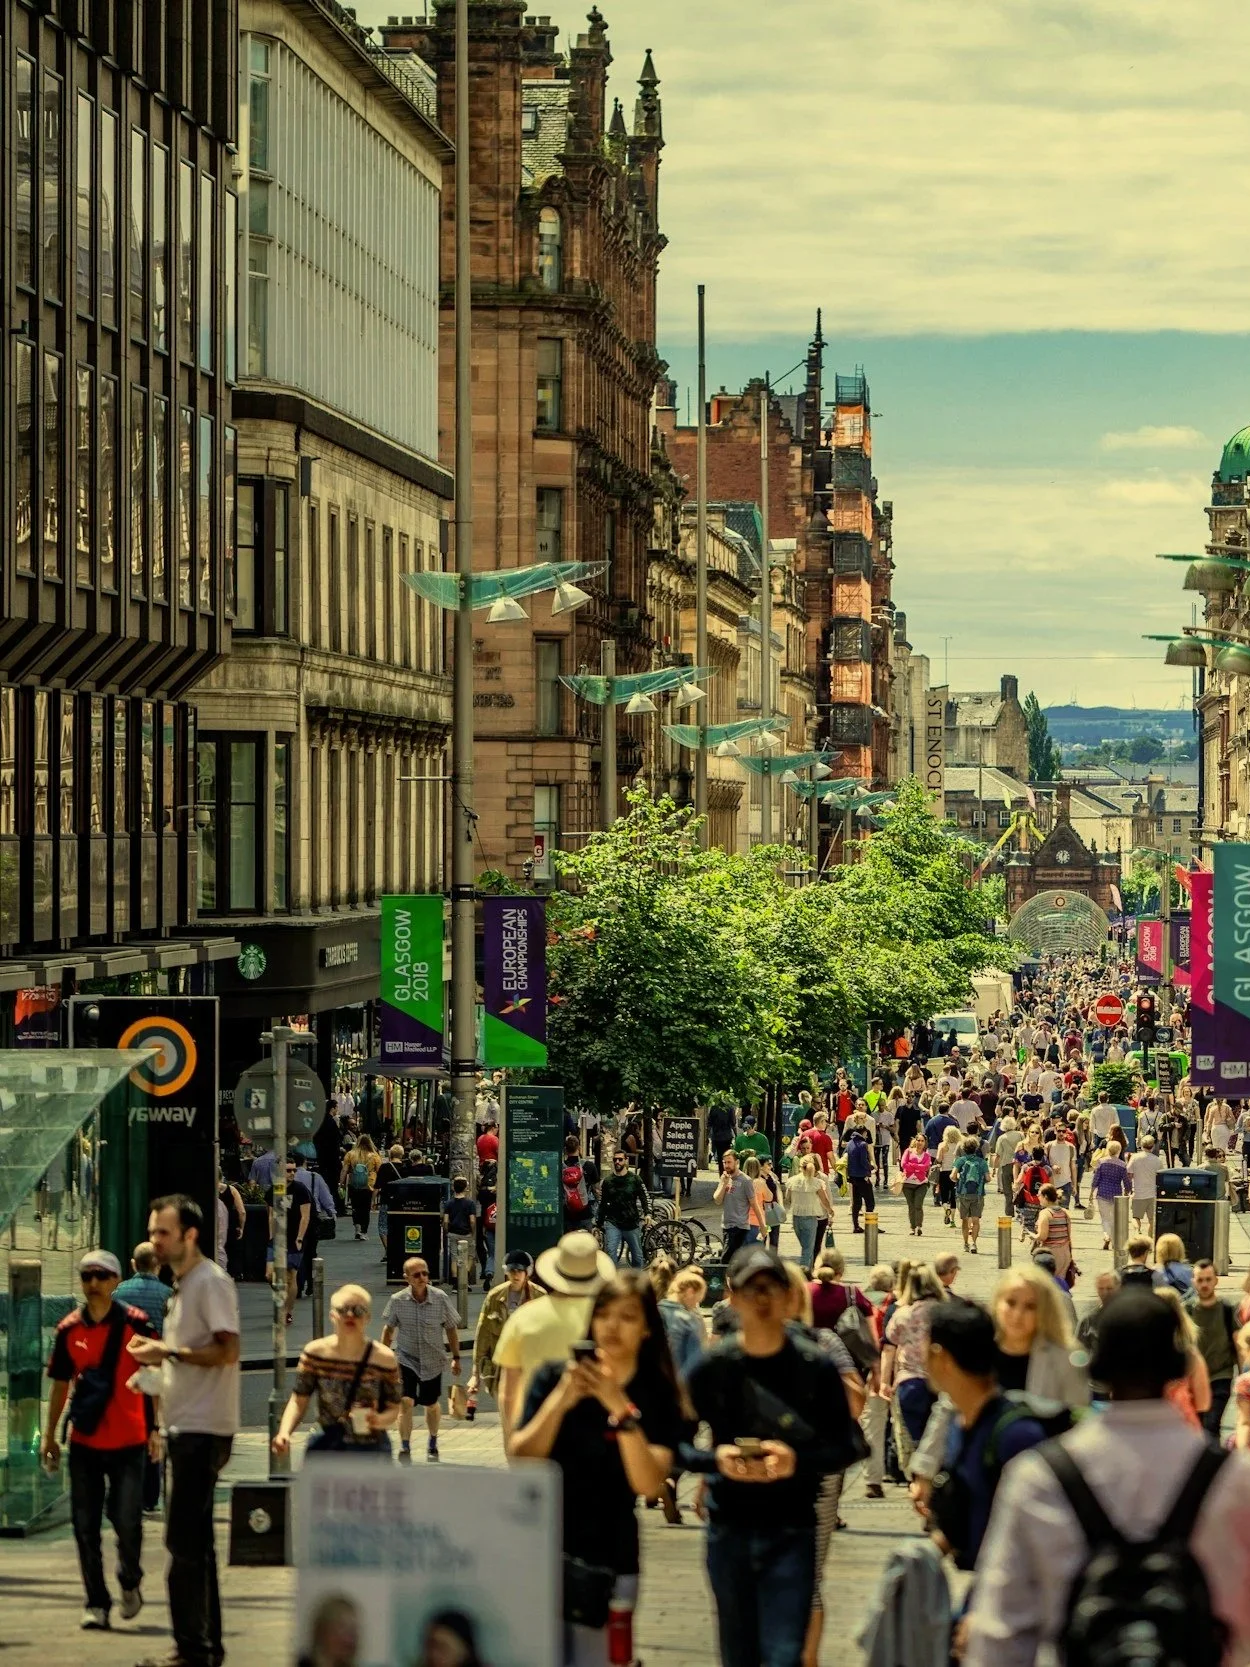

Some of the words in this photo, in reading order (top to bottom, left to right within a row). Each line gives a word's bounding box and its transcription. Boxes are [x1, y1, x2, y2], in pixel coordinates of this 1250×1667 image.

[928, 699, 942, 719] ST
[394, 908, 412, 1001] GLASGOW
[503, 908, 517, 991] EUROPEAN
[516, 908, 528, 990] CHAMPIONSHIPS
[1143, 926, 1151, 961] GLASGOW
[413, 962, 429, 1001] 2018
[387, 1042, 402, 1052] HM
[666, 1131, 686, 1139] Sales
[687, 1132, 694, 1140] &
[670, 1121, 692, 1131] Apple
[666, 1141, 694, 1151] Repairs
